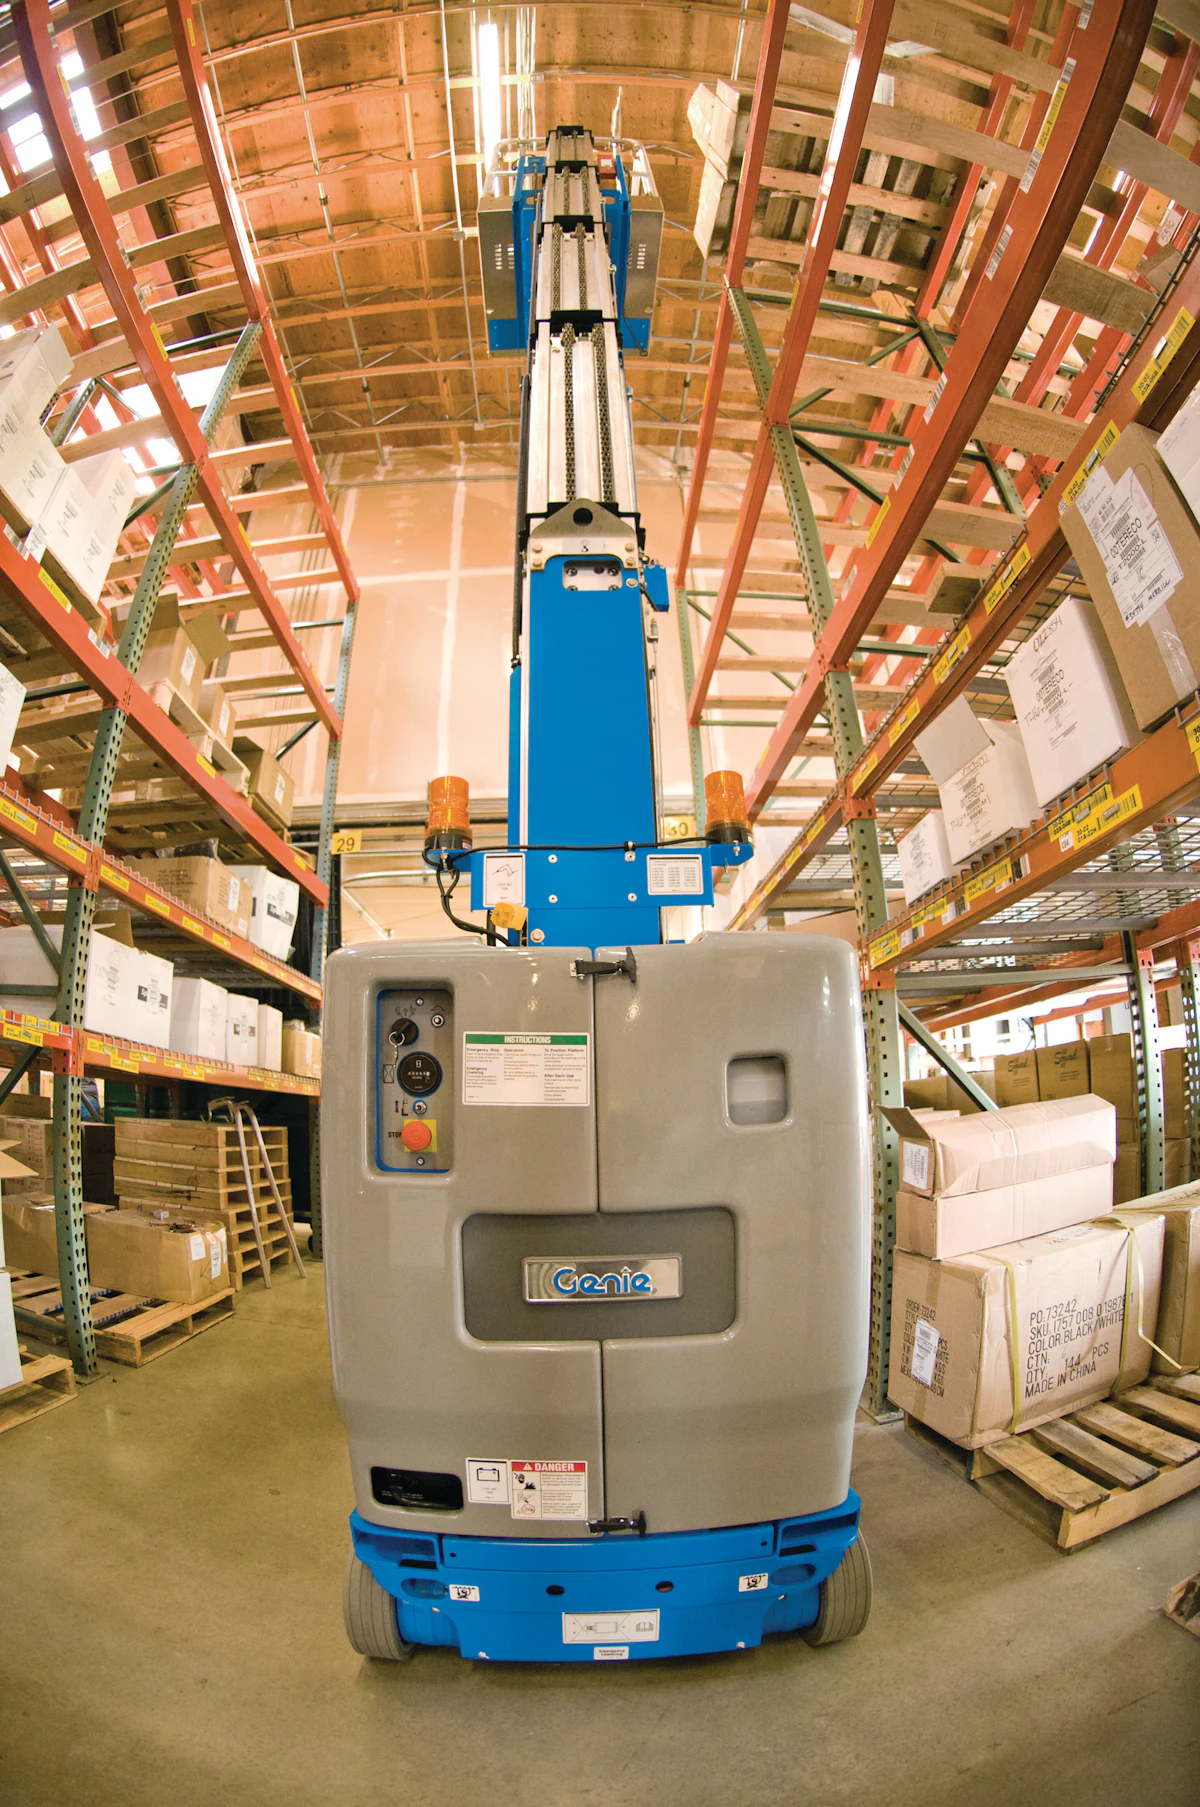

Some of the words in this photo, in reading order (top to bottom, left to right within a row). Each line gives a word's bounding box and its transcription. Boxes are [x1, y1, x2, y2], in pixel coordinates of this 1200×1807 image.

[337, 838, 355, 852] 29
[504, 1036, 551, 1044] INSTRUCTIONS
[1065, 1354, 1080, 1370] 144
[1092, 1342, 1109, 1360] PCS
[1025, 1377, 1054, 1398] MADE
[1057, 1372, 1066, 1387] IN
[1070, 1361, 1096, 1382] CHINA
[535, 1463, 574, 1471] DANGER
